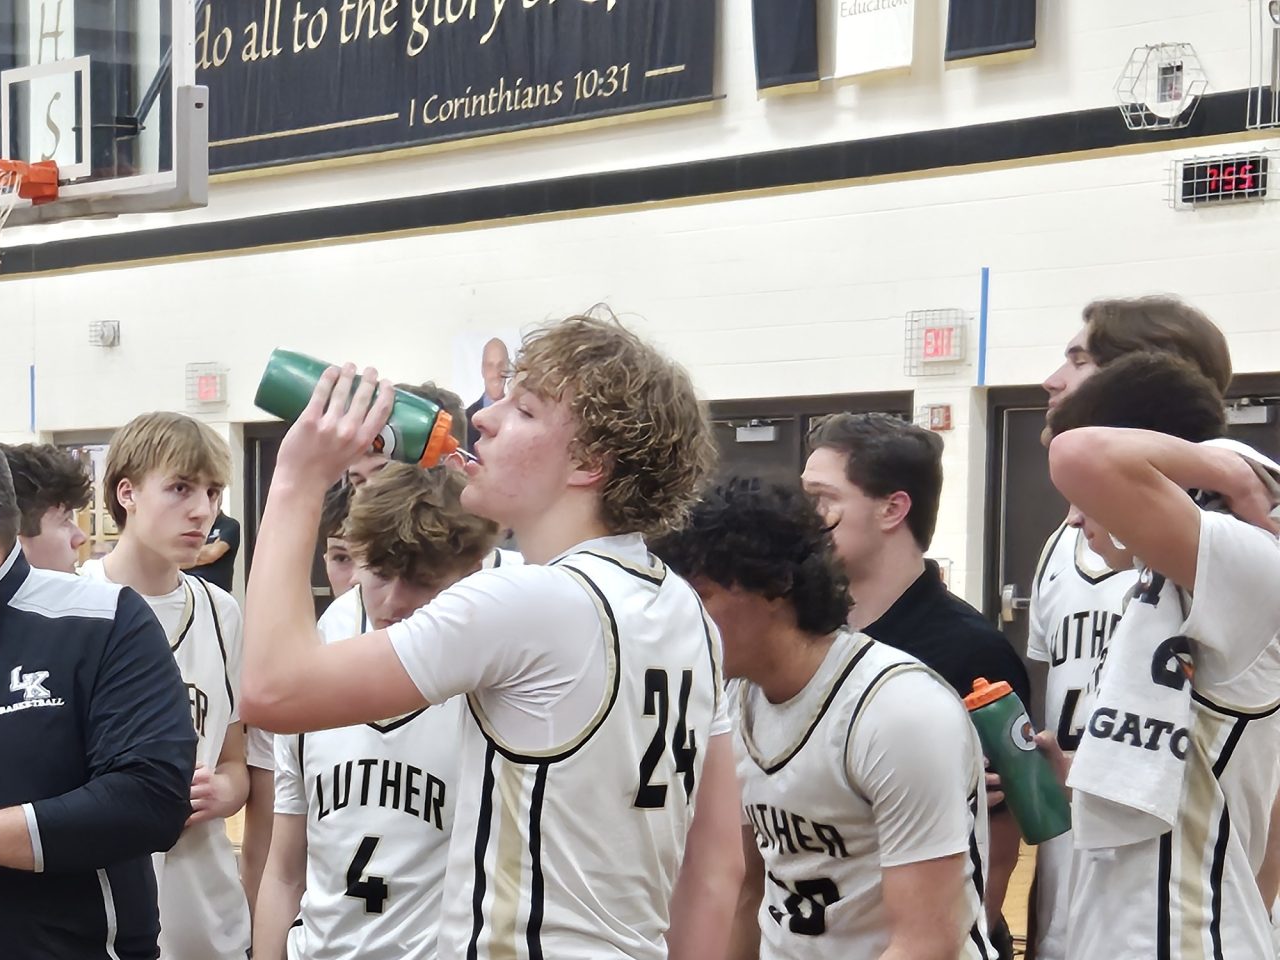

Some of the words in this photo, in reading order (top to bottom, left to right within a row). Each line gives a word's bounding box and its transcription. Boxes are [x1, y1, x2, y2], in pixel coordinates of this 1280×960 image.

[195, 3, 233, 70] do
[241, 0, 283, 62] all
[293, 1, 328, 53] to
[340, 0, 398, 44] the
[422, 76, 564, 125] Corinthians
[574, 62, 631, 101] 10:31
[633, 668, 697, 809] 24
[316, 758, 446, 831] LUTHER
[344, 836, 388, 914] 4
